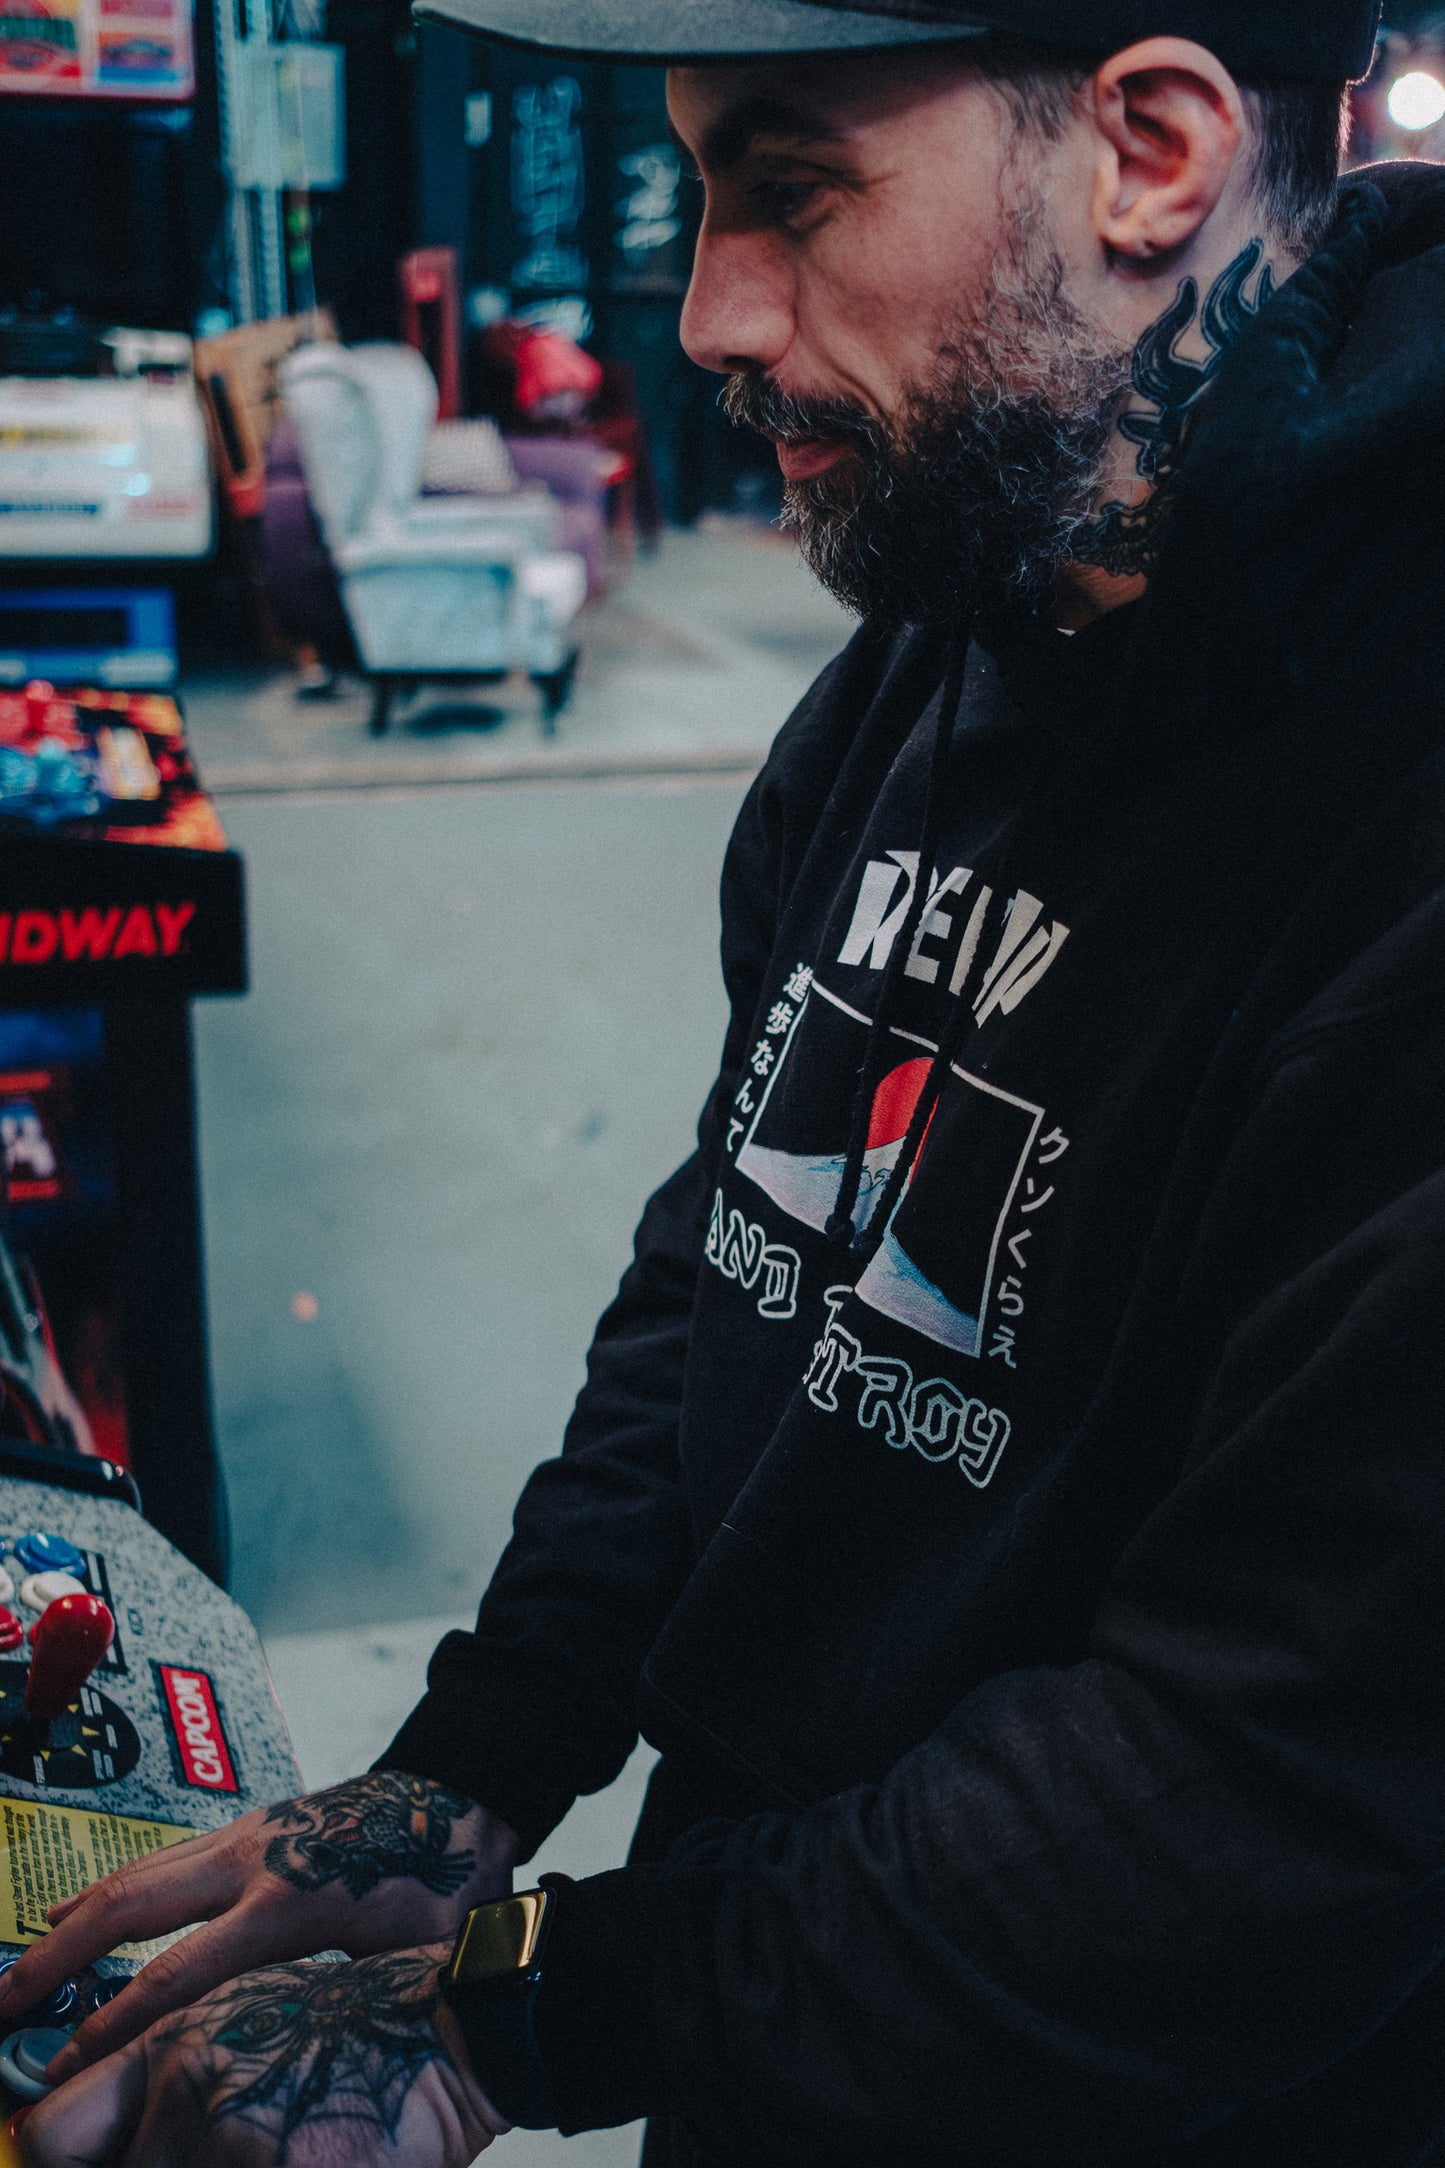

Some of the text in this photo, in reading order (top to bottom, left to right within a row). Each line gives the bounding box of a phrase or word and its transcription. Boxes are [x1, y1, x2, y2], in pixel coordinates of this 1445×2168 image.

[988, 1126, 1069, 1368] クソくらえ
[171, 1675, 224, 1783] CAPCOM
